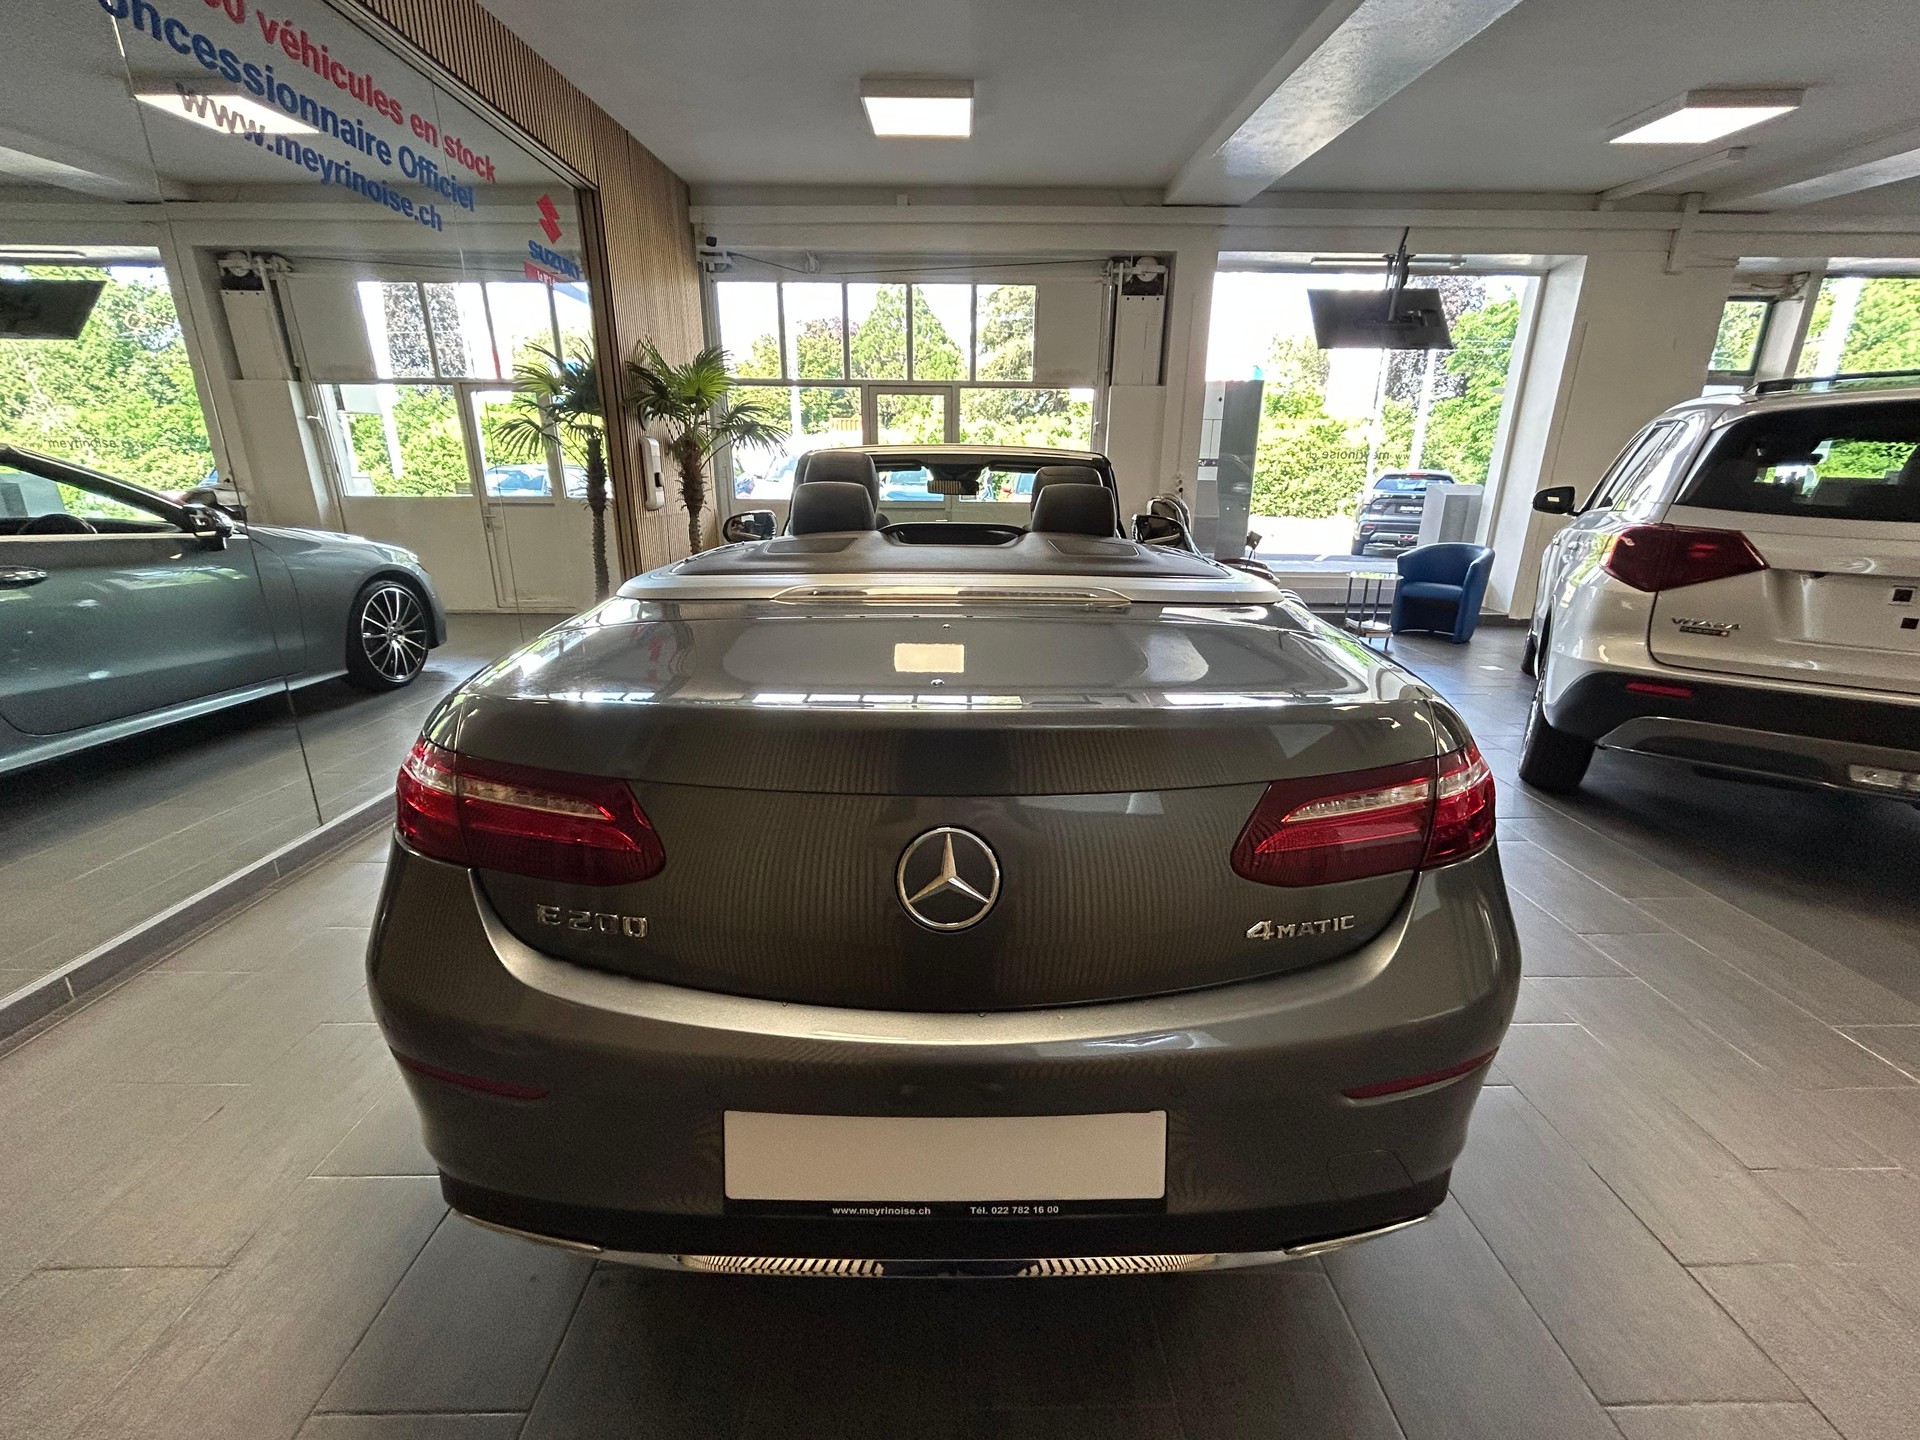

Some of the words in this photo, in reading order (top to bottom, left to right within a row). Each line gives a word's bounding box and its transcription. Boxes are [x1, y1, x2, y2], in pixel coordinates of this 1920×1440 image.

[256, 9, 404, 126] véhicules
[410, 113, 438, 148] en
[443, 134, 496, 184] stock
[175, 82, 443, 232] www.meyrinoise.ch
[398, 145, 475, 213] Officiel
[537, 903, 561, 926] E
[568, 909, 648, 938] 200
[832, 1206, 931, 1217] www.meyrinoise.ch
[970, 1206, 988, 1215] Tél.
[991, 1206, 1009, 1215] 022
[1012, 1206, 1030, 1214] 782
[1033, 1206, 1044, 1214] 16
[1047, 1206, 1059, 1214] 00
